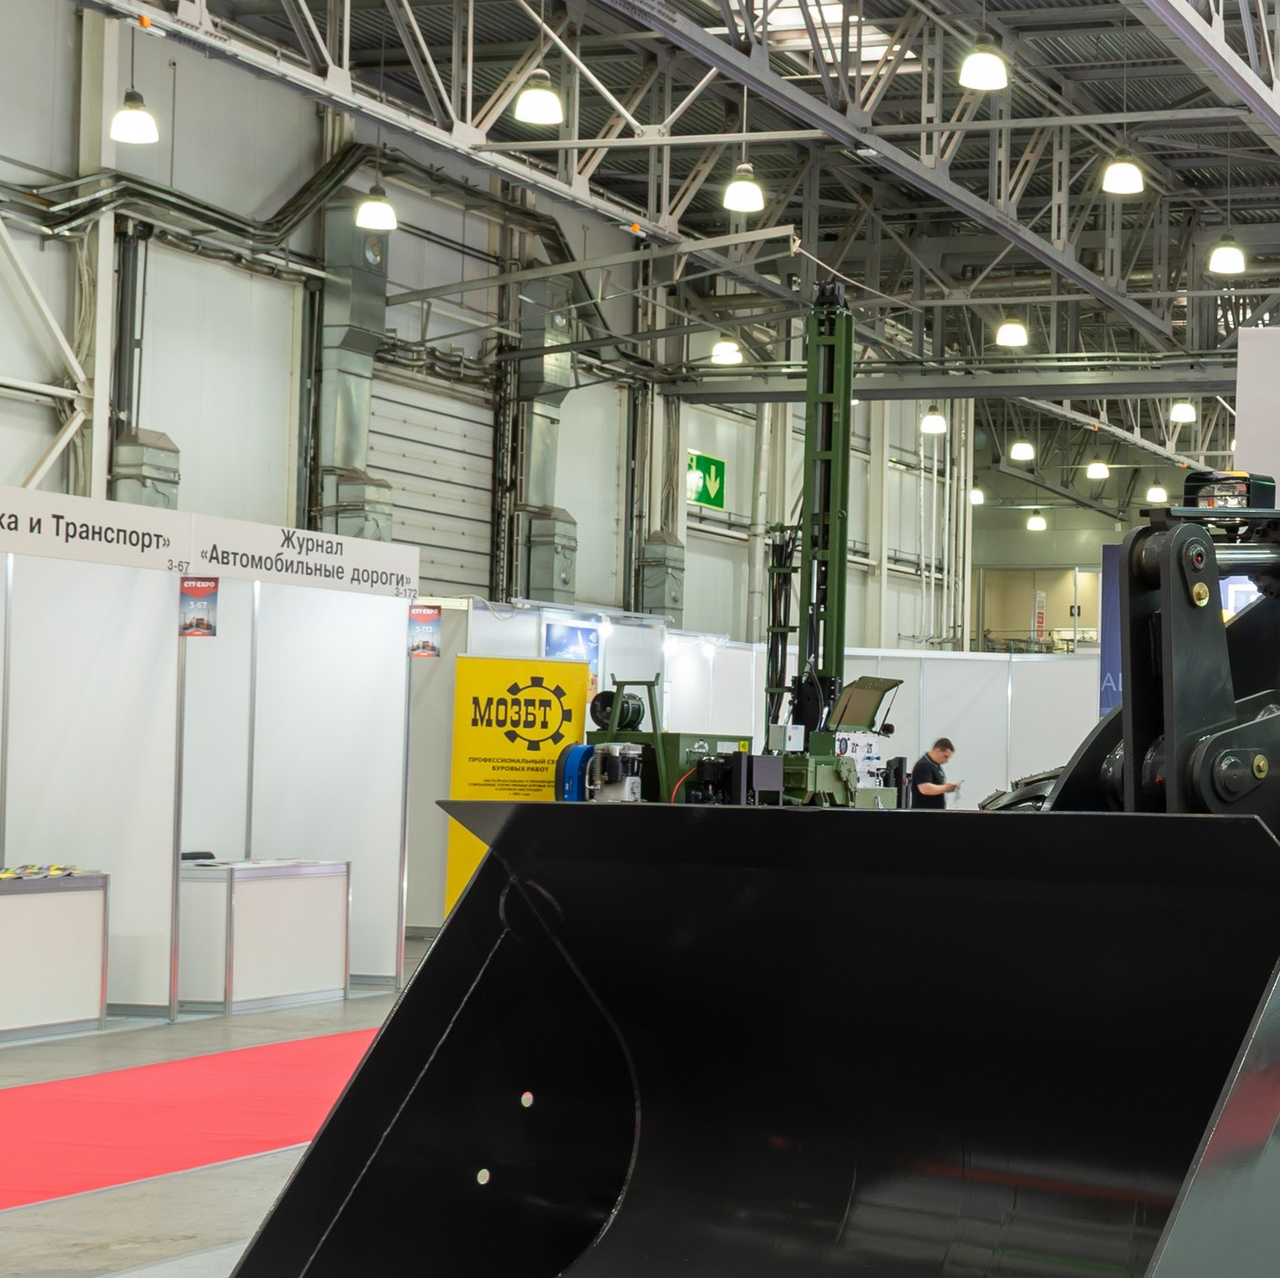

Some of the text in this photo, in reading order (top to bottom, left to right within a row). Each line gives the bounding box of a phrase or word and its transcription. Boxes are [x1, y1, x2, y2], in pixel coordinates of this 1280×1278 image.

[29, 516, 42, 534] и
[52, 513, 171, 553] Транспорт»
[280, 528, 344, 557] Журнал
[167, 559, 190, 572] 3-67
[200, 544, 412, 589] «Автомобильные дороги»
[395, 587, 418, 599] 3-172
[188, 601, 208, 609] 3-67
[471, 696, 552, 729] МОЗБТ
[468, 756, 546, 765] ПРОФЕССИОНАЛЬНЫЙ
